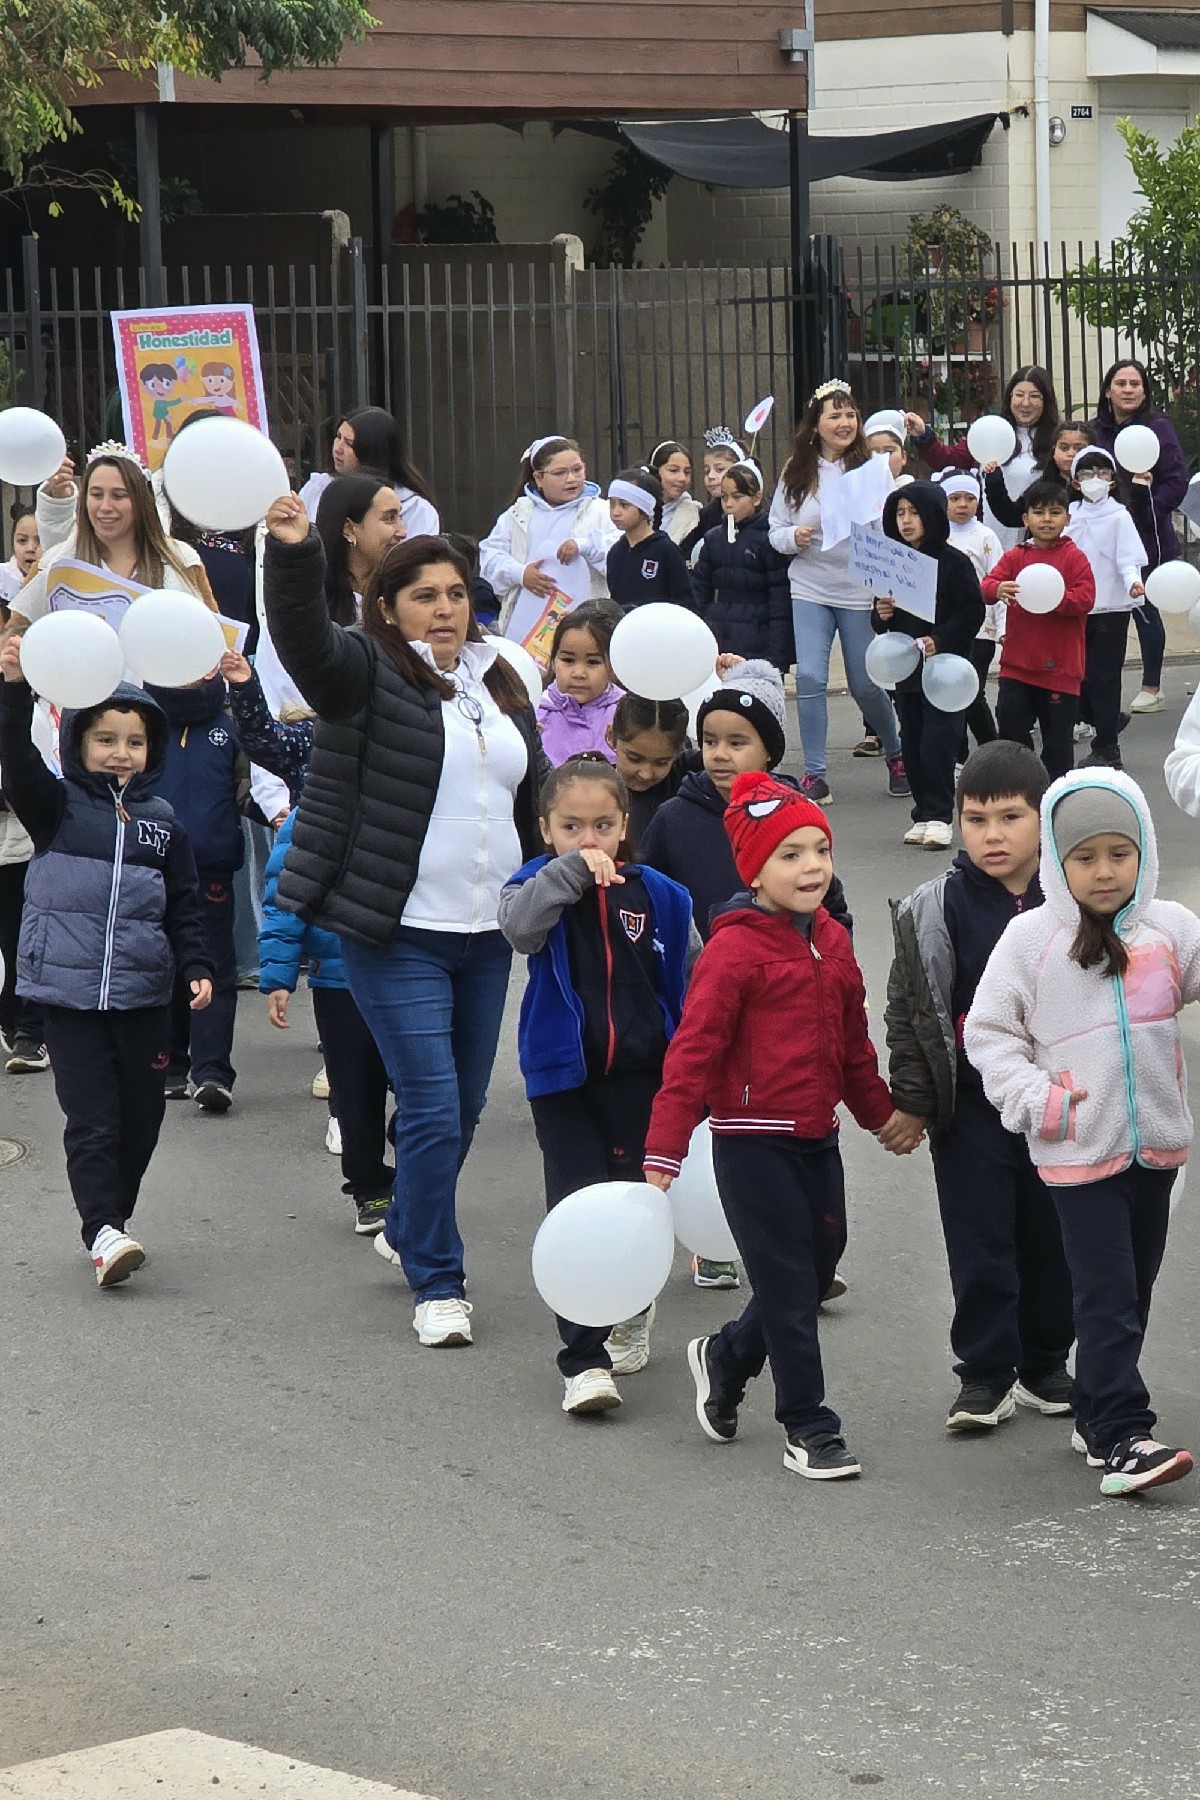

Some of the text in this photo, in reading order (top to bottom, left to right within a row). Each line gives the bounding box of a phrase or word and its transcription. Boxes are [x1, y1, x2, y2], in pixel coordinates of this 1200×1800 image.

[1073, 107, 1090, 117] 2764
[138, 330, 232, 350] Honestidad
[137, 819, 171, 857] NY
